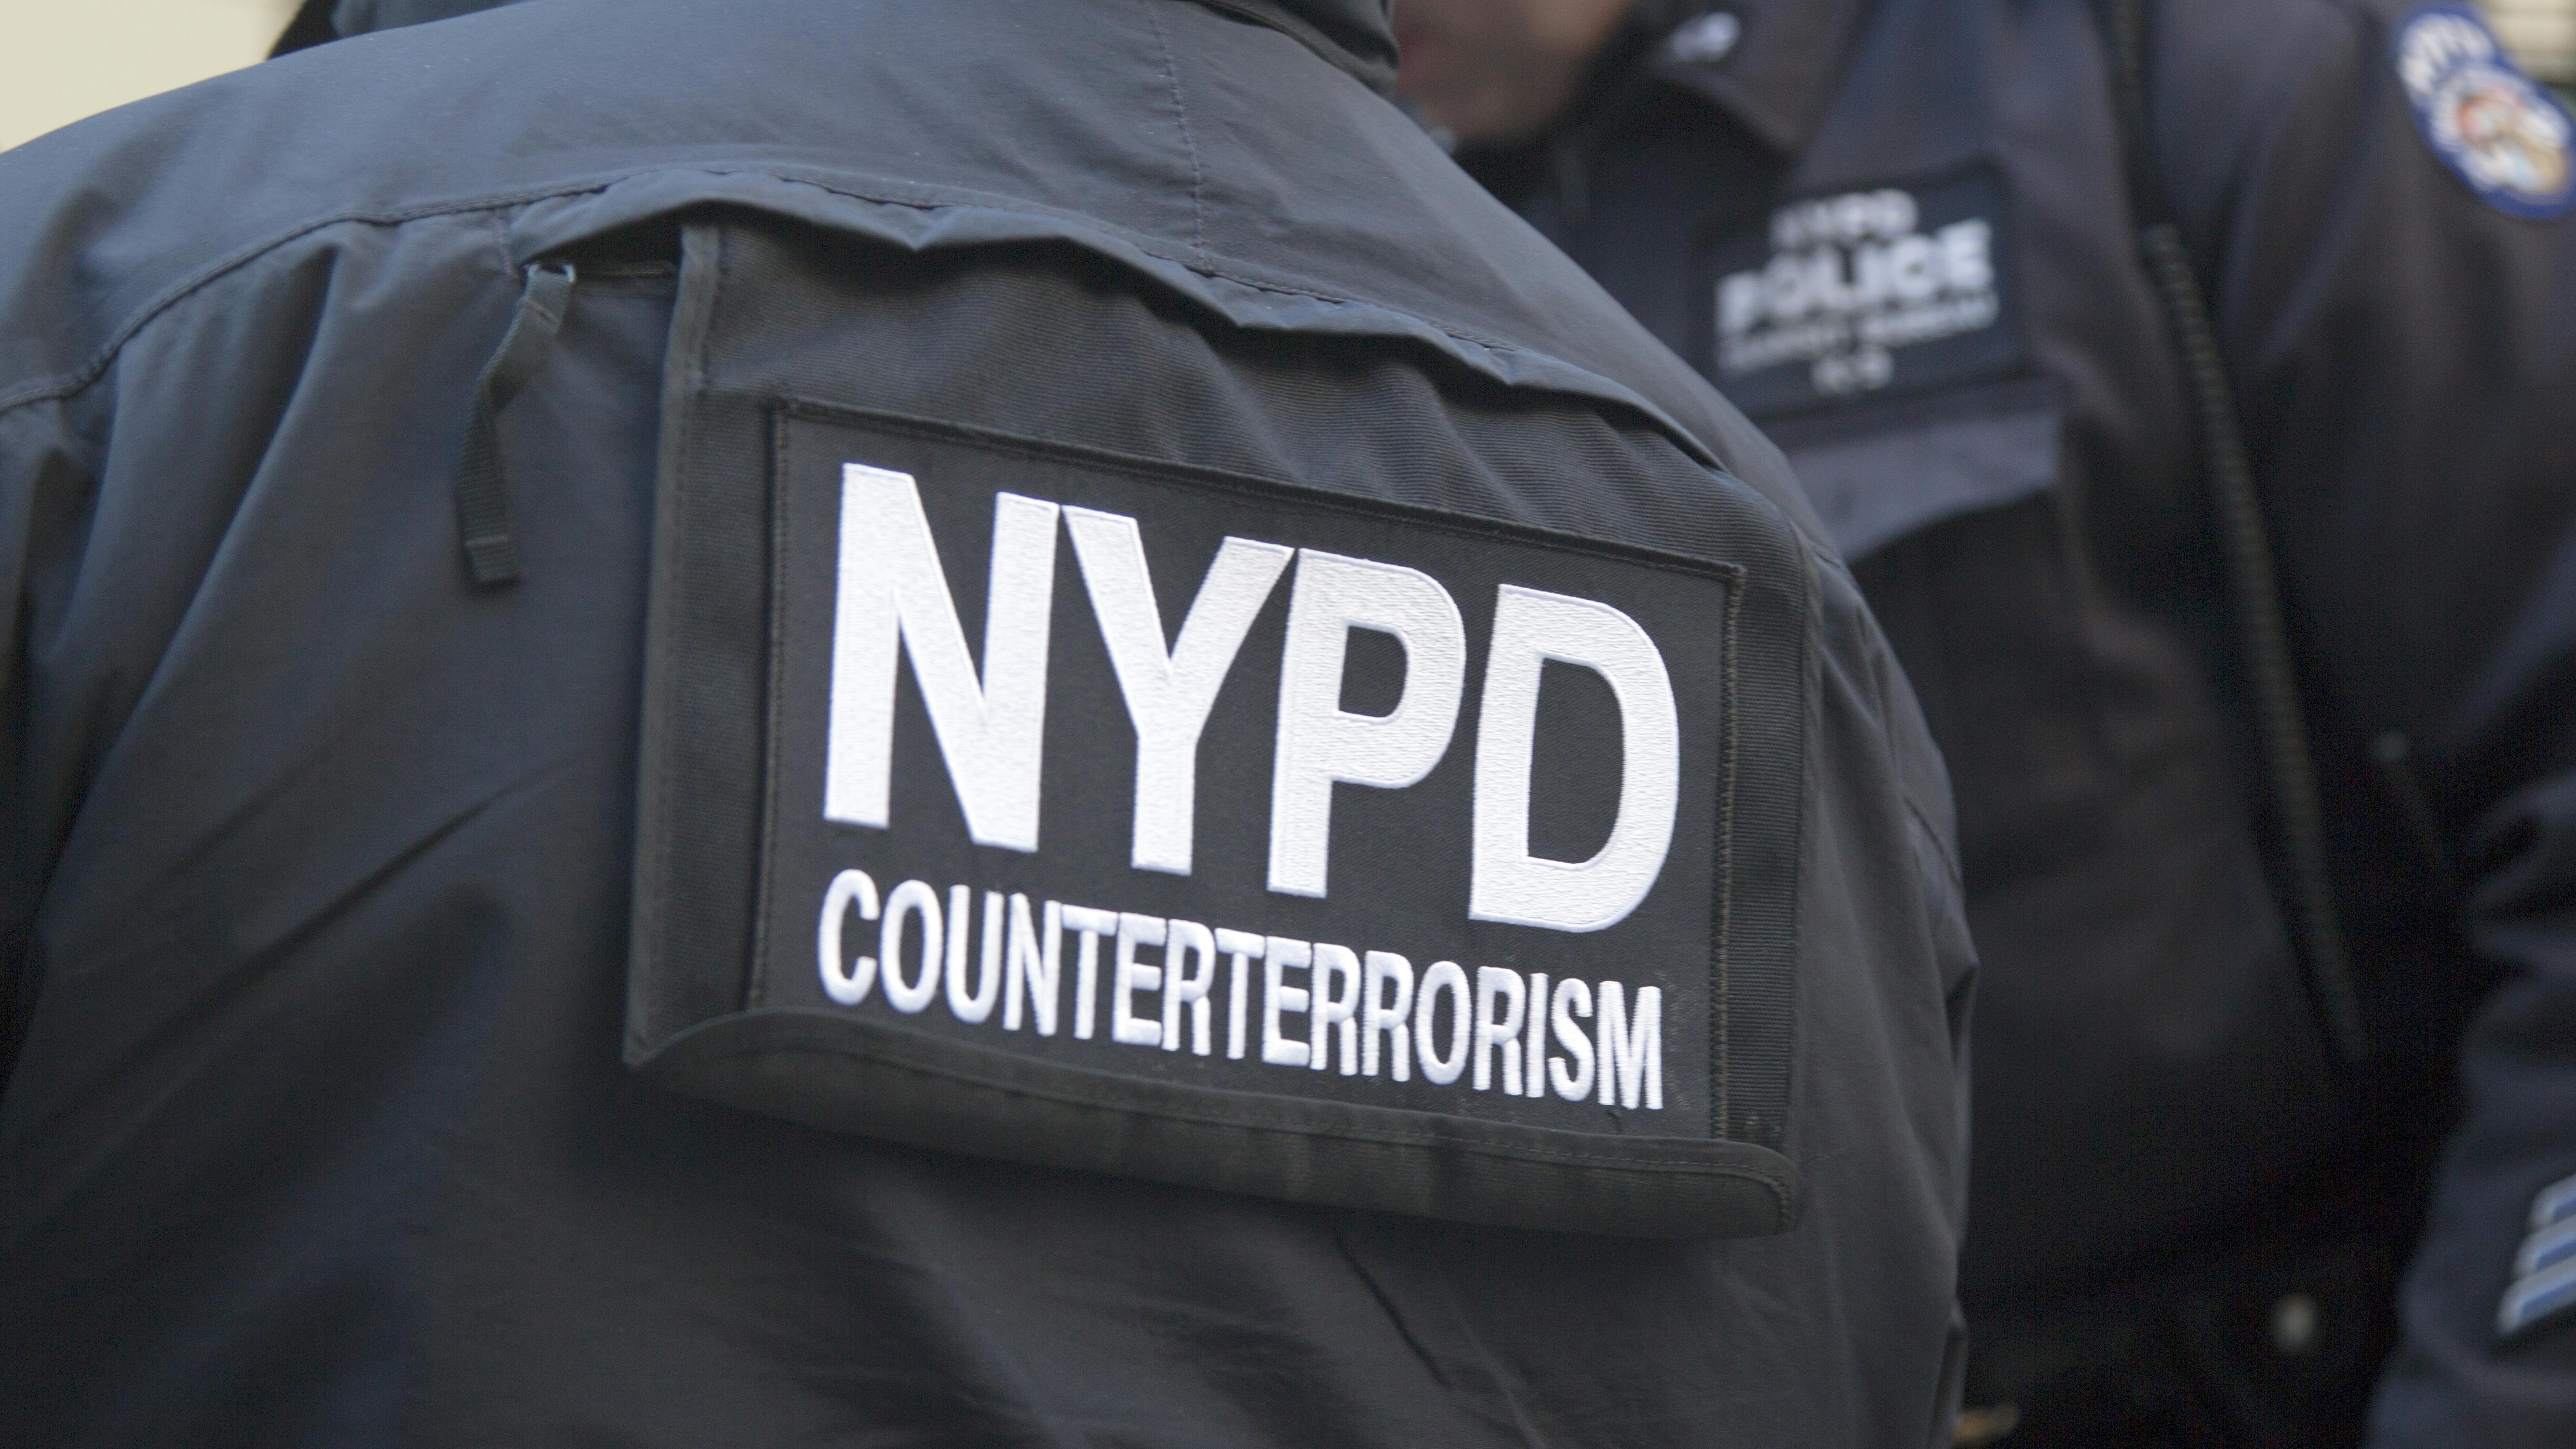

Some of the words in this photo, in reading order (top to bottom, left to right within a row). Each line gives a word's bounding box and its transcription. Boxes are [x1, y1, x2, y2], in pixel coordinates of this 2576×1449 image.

[1719, 219, 1994, 335] POLICE
[824, 463, 1680, 934] NYPD
[818, 869, 1664, 1110] COUNTERTERRORISM
